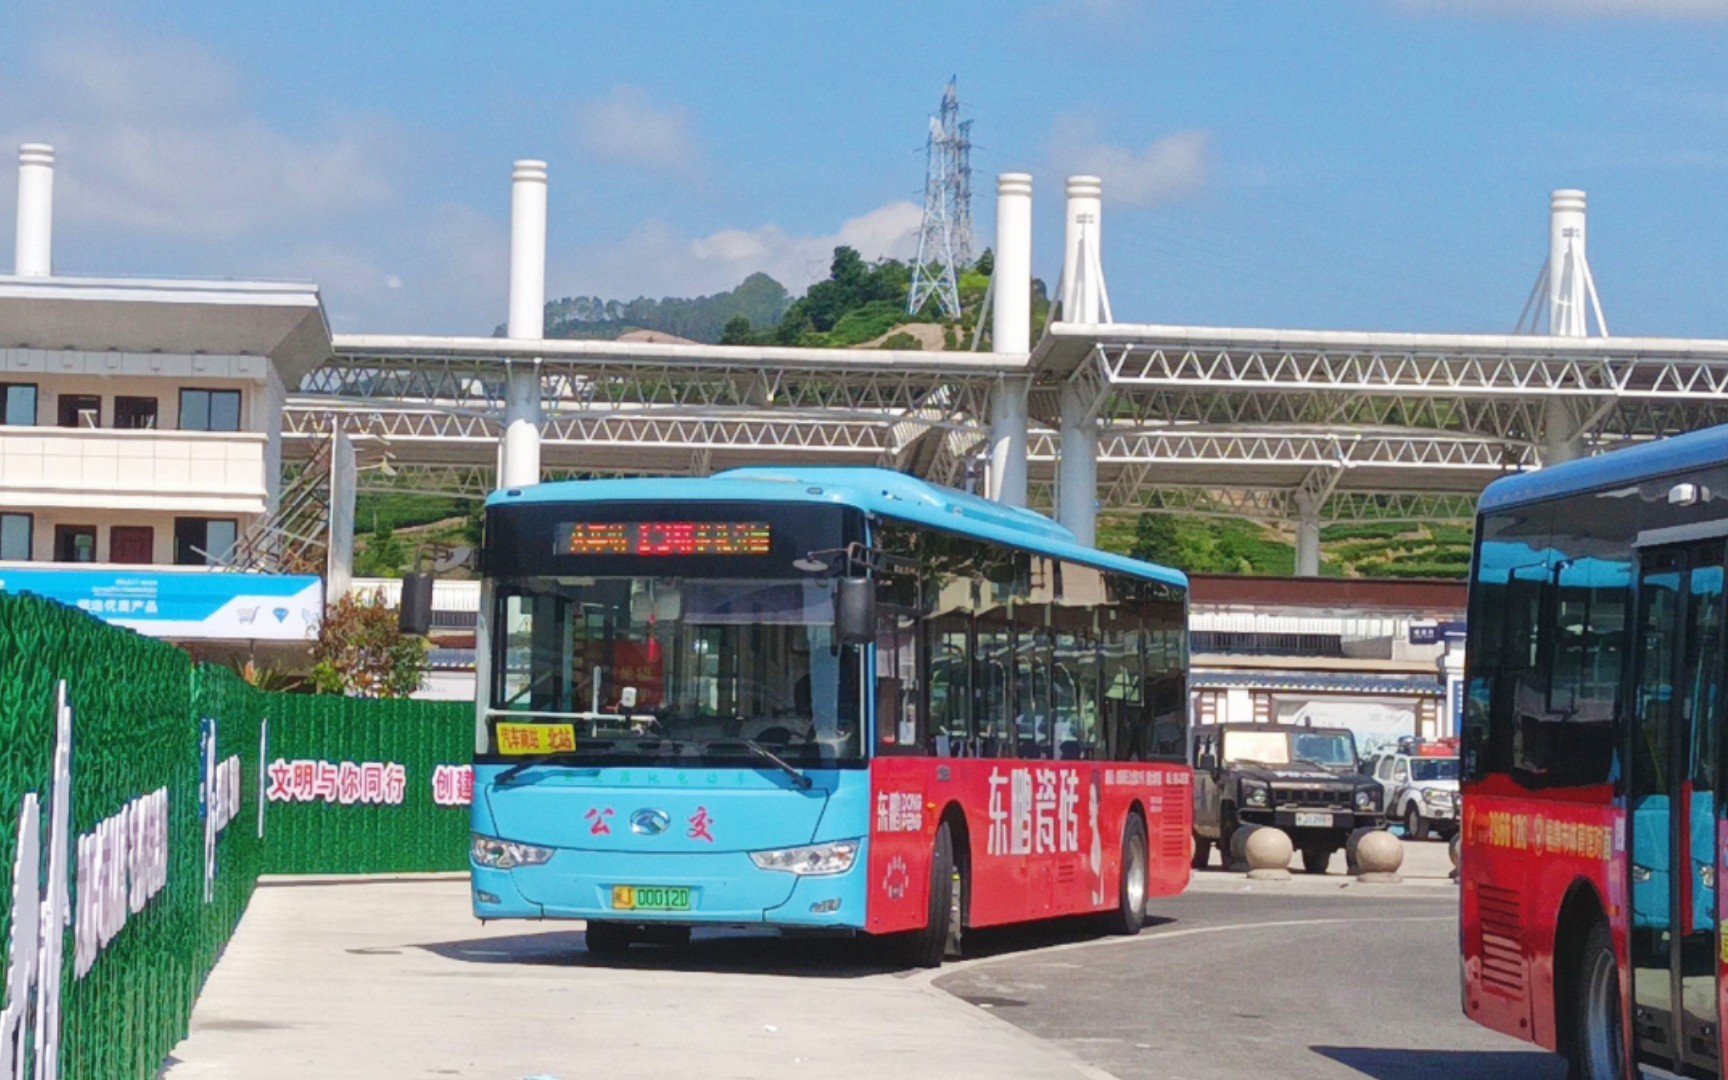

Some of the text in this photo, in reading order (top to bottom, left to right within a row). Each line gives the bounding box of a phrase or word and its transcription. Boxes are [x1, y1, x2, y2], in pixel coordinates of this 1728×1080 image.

[267, 759, 406, 803] 文明与你同行
[584, 806, 715, 844] 公 交
[877, 790, 900, 832] 东鹏
[987, 766, 1079, 857] 东鹏瓷砖
